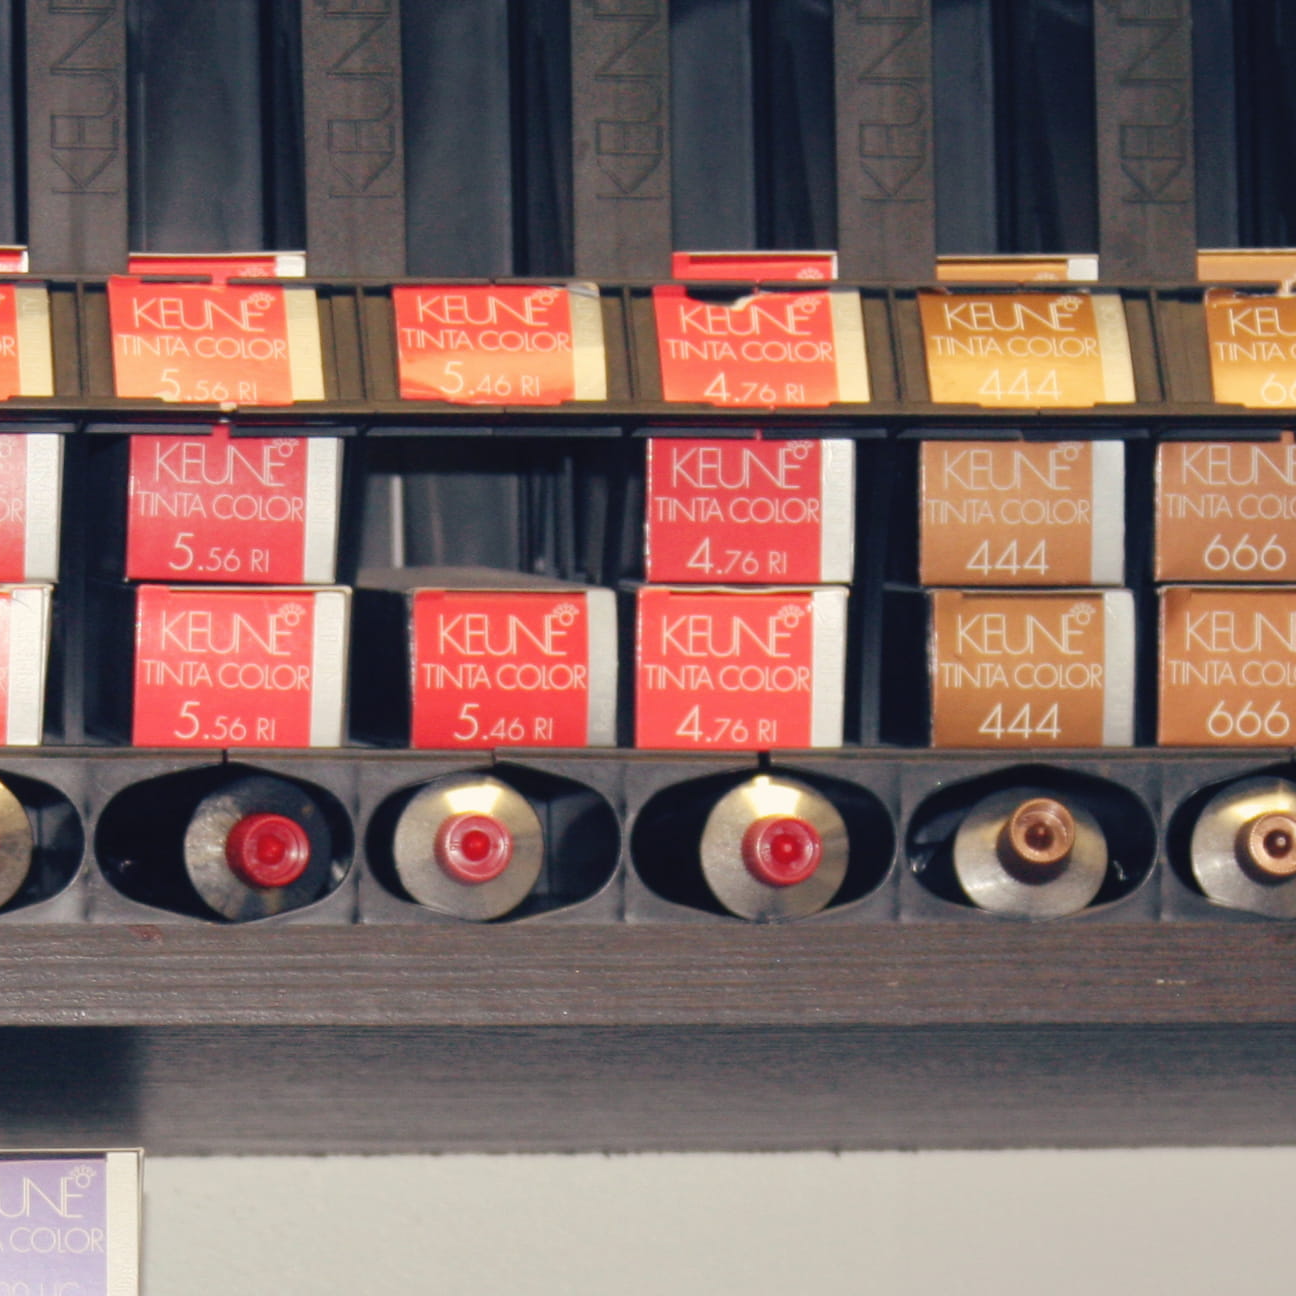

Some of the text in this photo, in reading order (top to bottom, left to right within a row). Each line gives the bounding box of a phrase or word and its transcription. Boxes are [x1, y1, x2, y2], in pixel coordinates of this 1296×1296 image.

[417, 294, 550, 325] KEUNE
[680, 304, 812, 336] KEUNE
[943, 303, 1074, 331] KEUNE
[402, 328, 571, 353] TINTA COLOR
[666, 338, 837, 363] TINTA COLOR
[930, 336, 1099, 361] TINTA COLOR
[439, 361, 540, 396] 5.46 RI
[704, 373, 805, 403] 4.76 RI
[978, 370, 1061, 401] 444
[671, 447, 801, 488] KEUNE
[655, 495, 821, 523] TINTA COLOR
[1164, 494, 1236, 517] TINTA
[687, 537, 787, 574] 4.76 RI
[1204, 534, 1286, 571] 666
[160, 613, 296, 655] KEUNE
[956, 613, 1083, 653] KEUNE
[141, 660, 309, 690] TINTA COLOR
[940, 662, 1103, 689] TINTA COLOR
[173, 701, 276, 740] 5.56 RI
[978, 705, 1061, 739] 444
